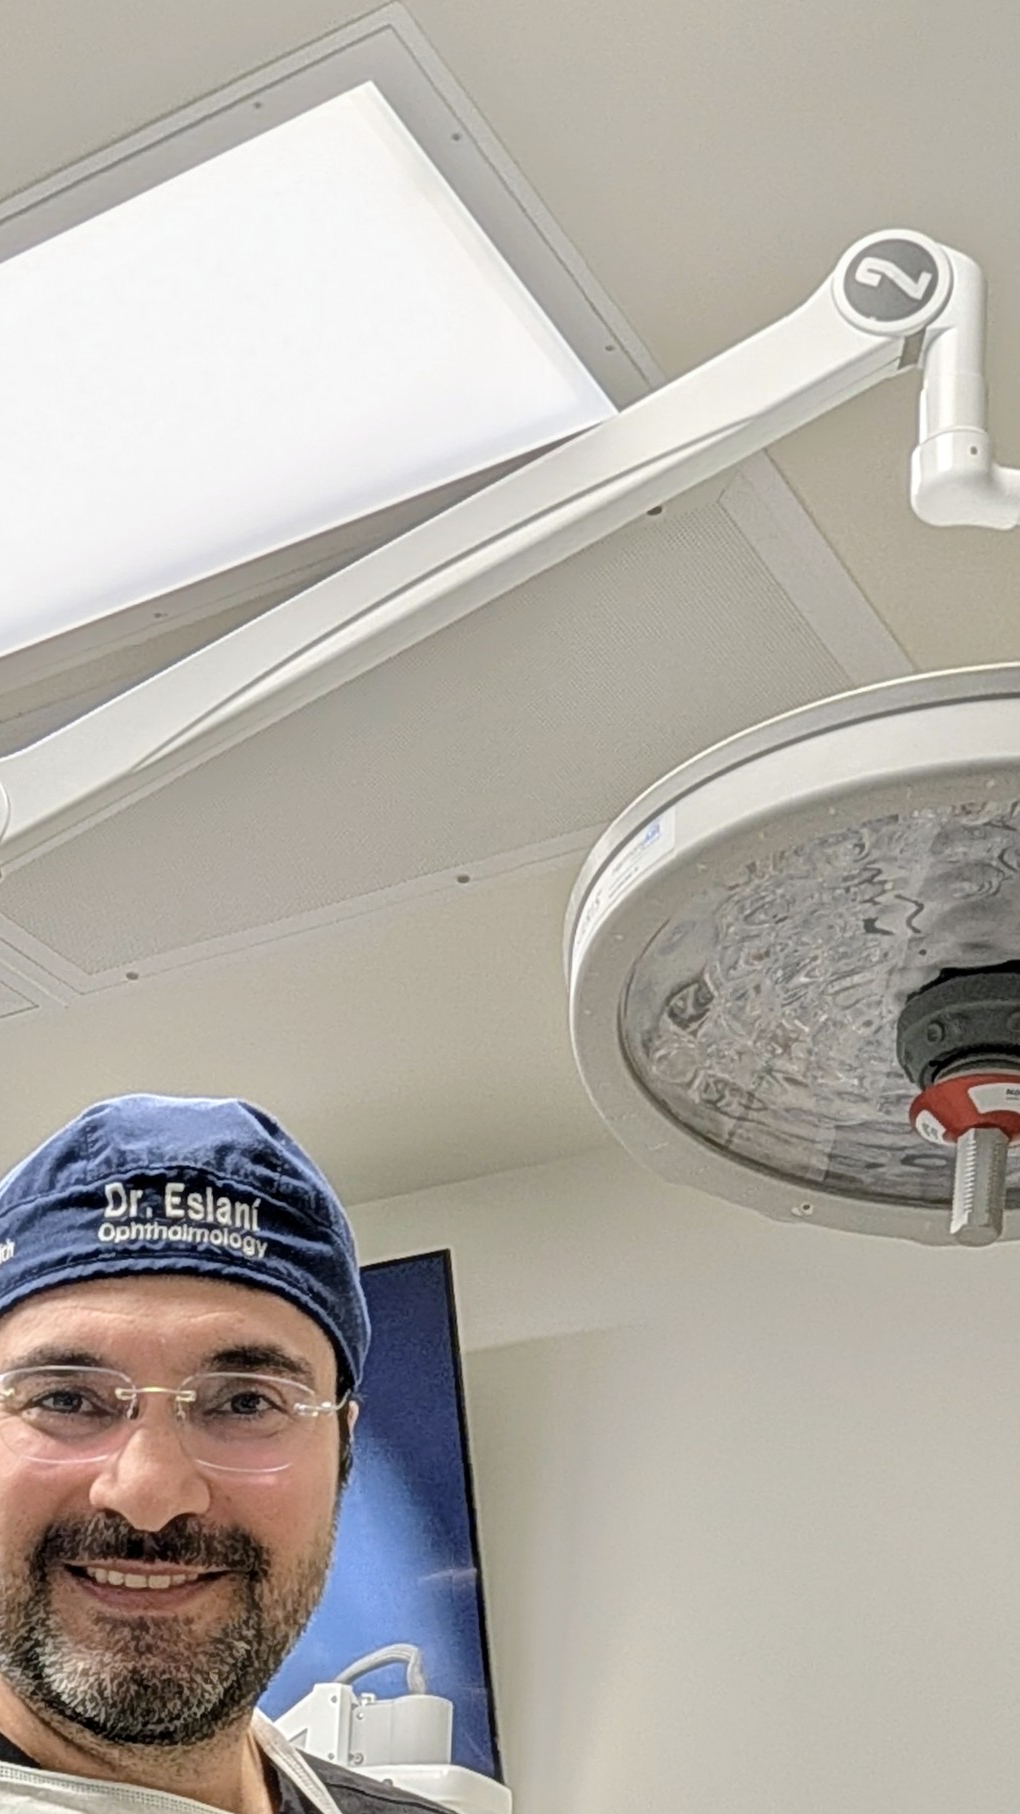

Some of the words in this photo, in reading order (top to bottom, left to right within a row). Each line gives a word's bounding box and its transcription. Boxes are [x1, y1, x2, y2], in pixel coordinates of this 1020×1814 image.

[855, 256, 933, 301] 2
[104, 1182, 153, 1218] Dr.
[164, 1182, 262, 1232] Eslani
[97, 1221, 268, 1259] Ophthalmology
